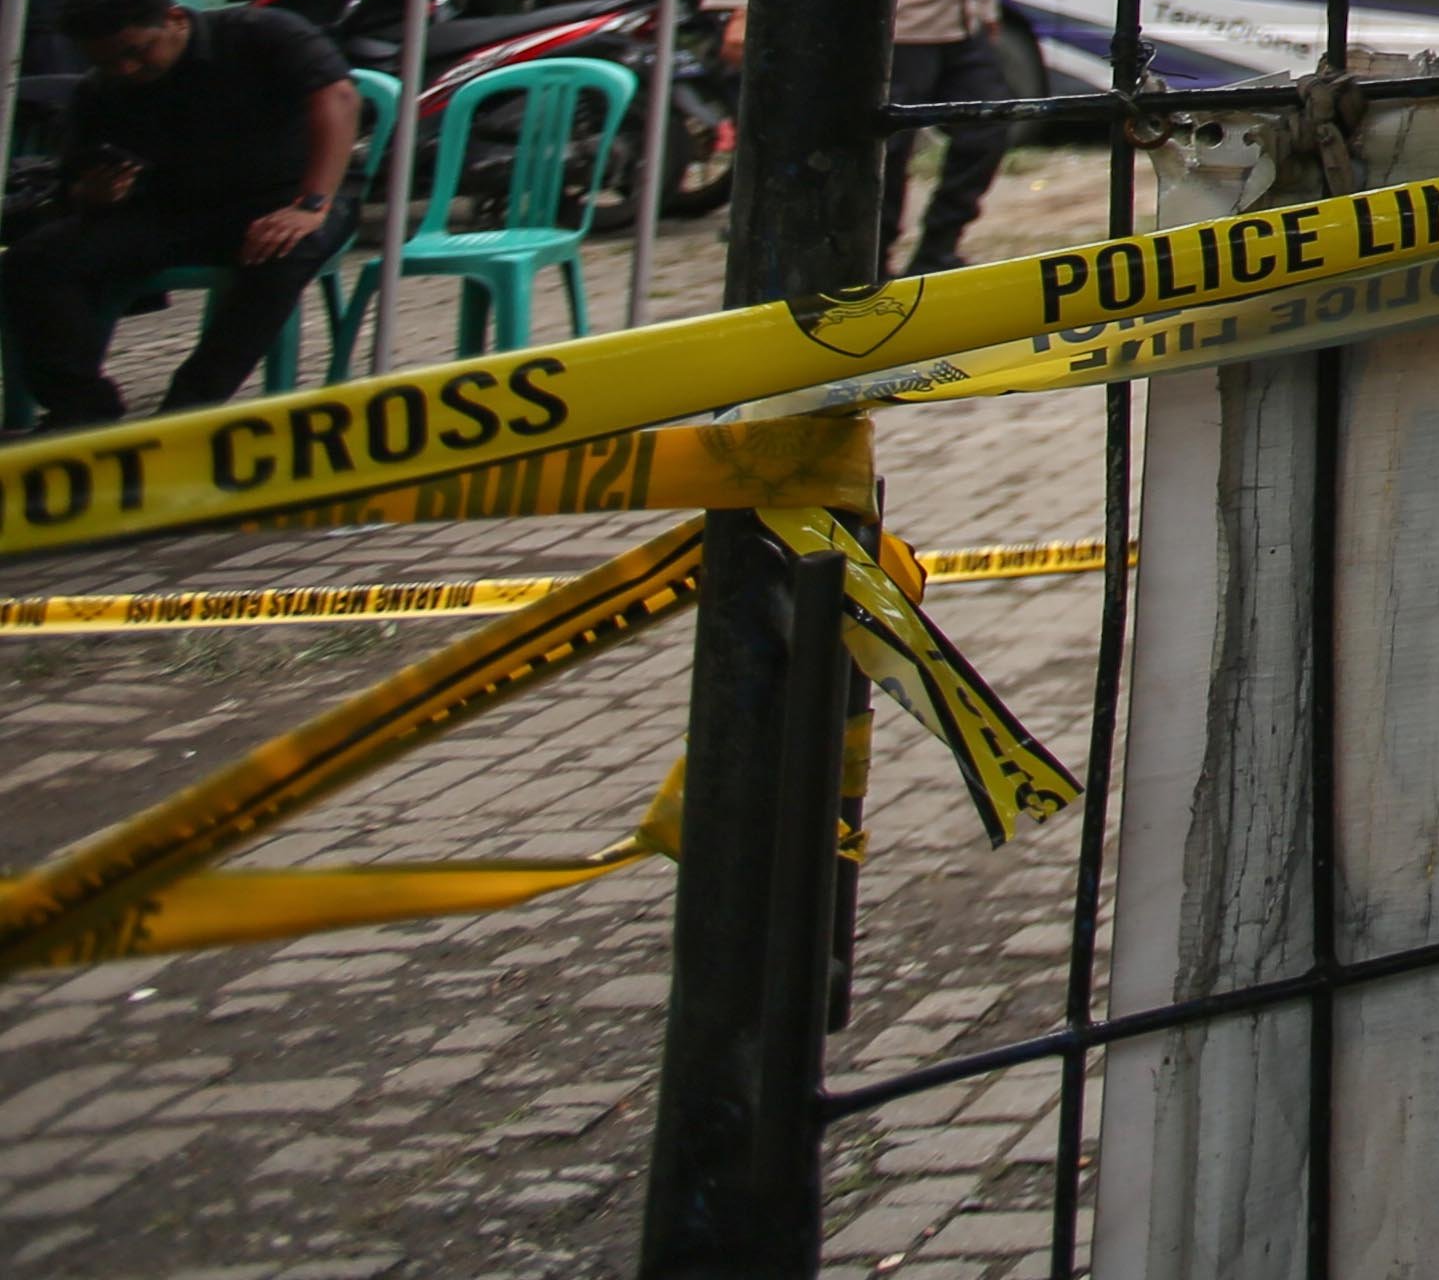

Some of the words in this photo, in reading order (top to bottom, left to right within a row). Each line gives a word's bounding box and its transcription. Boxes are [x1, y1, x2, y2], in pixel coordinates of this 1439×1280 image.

[1041, 201, 1323, 325] POLICE
[0, 438, 163, 535] OT
[210, 354, 569, 493] CROSS
